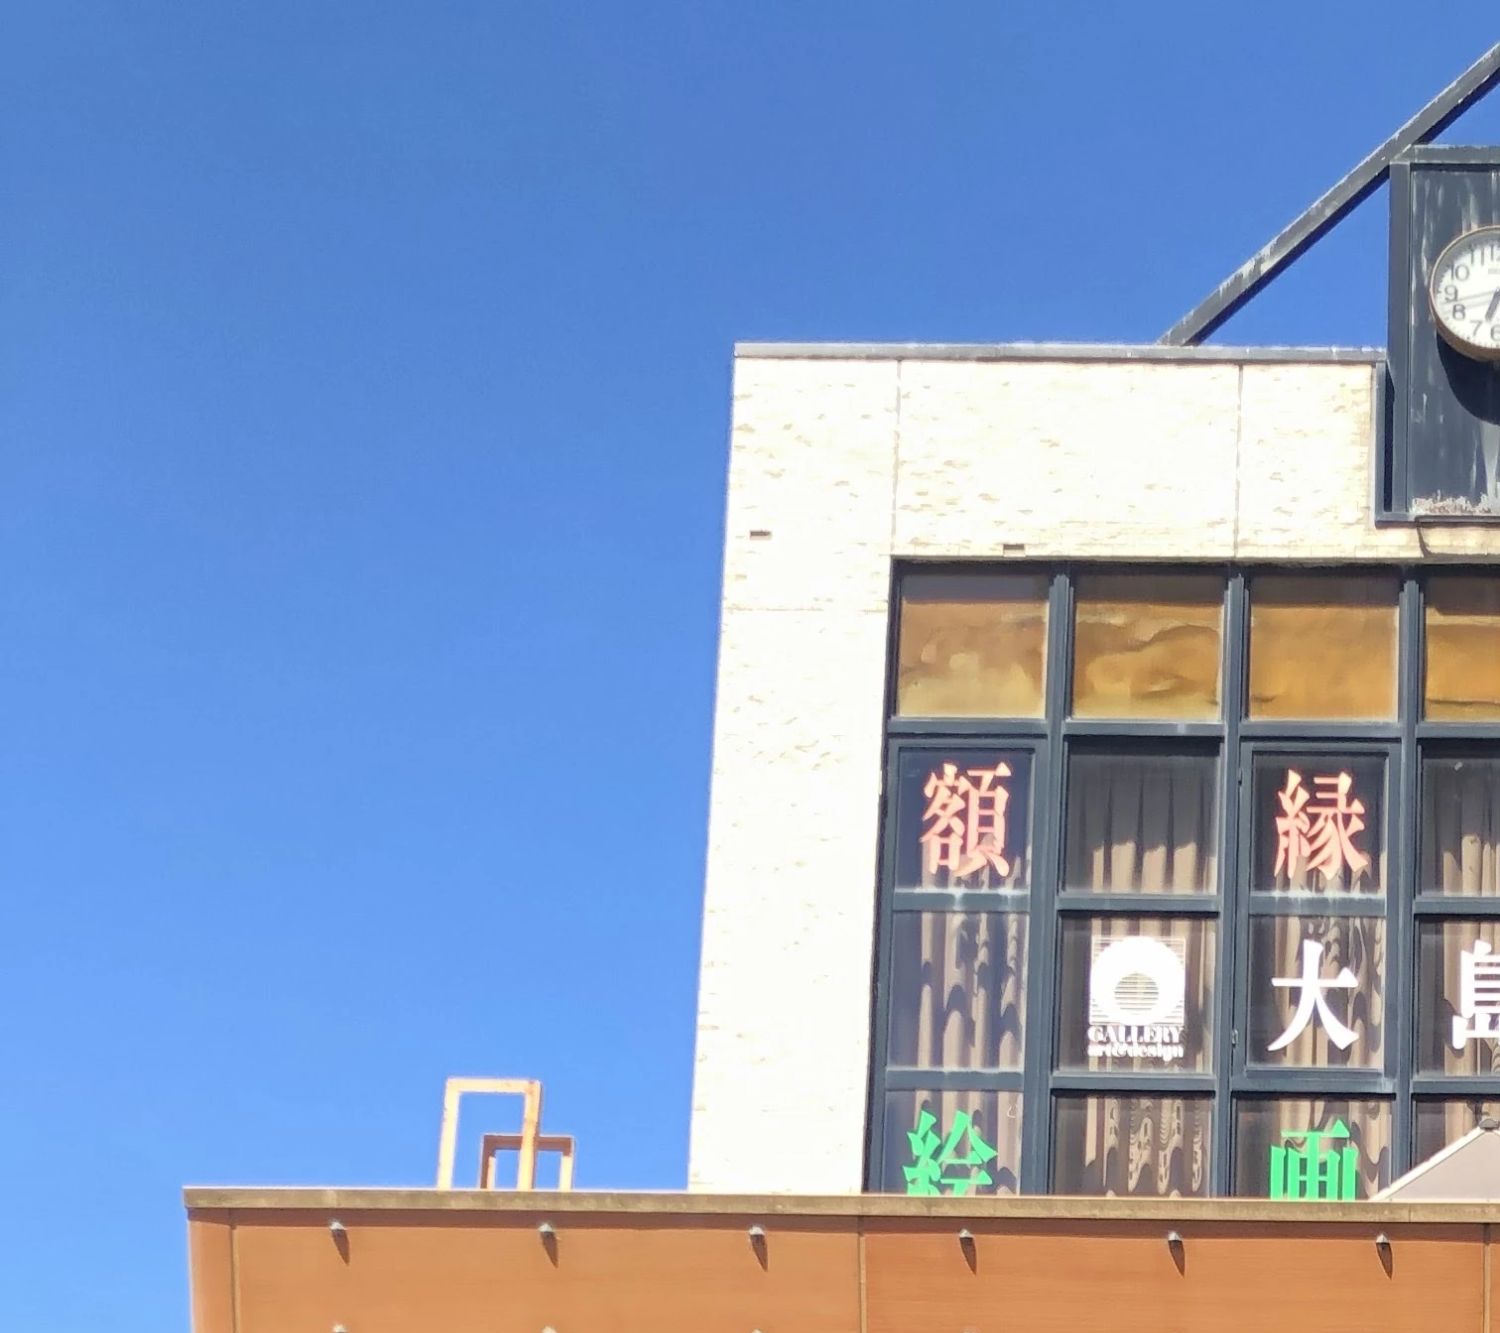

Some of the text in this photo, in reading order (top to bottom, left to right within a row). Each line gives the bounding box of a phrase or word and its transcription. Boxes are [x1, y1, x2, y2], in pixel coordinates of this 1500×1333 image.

[1451, 260, 1470, 281] 10
[1443, 284, 1459, 303] 9
[1451, 303, 1467, 321] 8
[1469, 319, 1484, 338] 7
[1087, 1024, 1184, 1044] GALLERY
